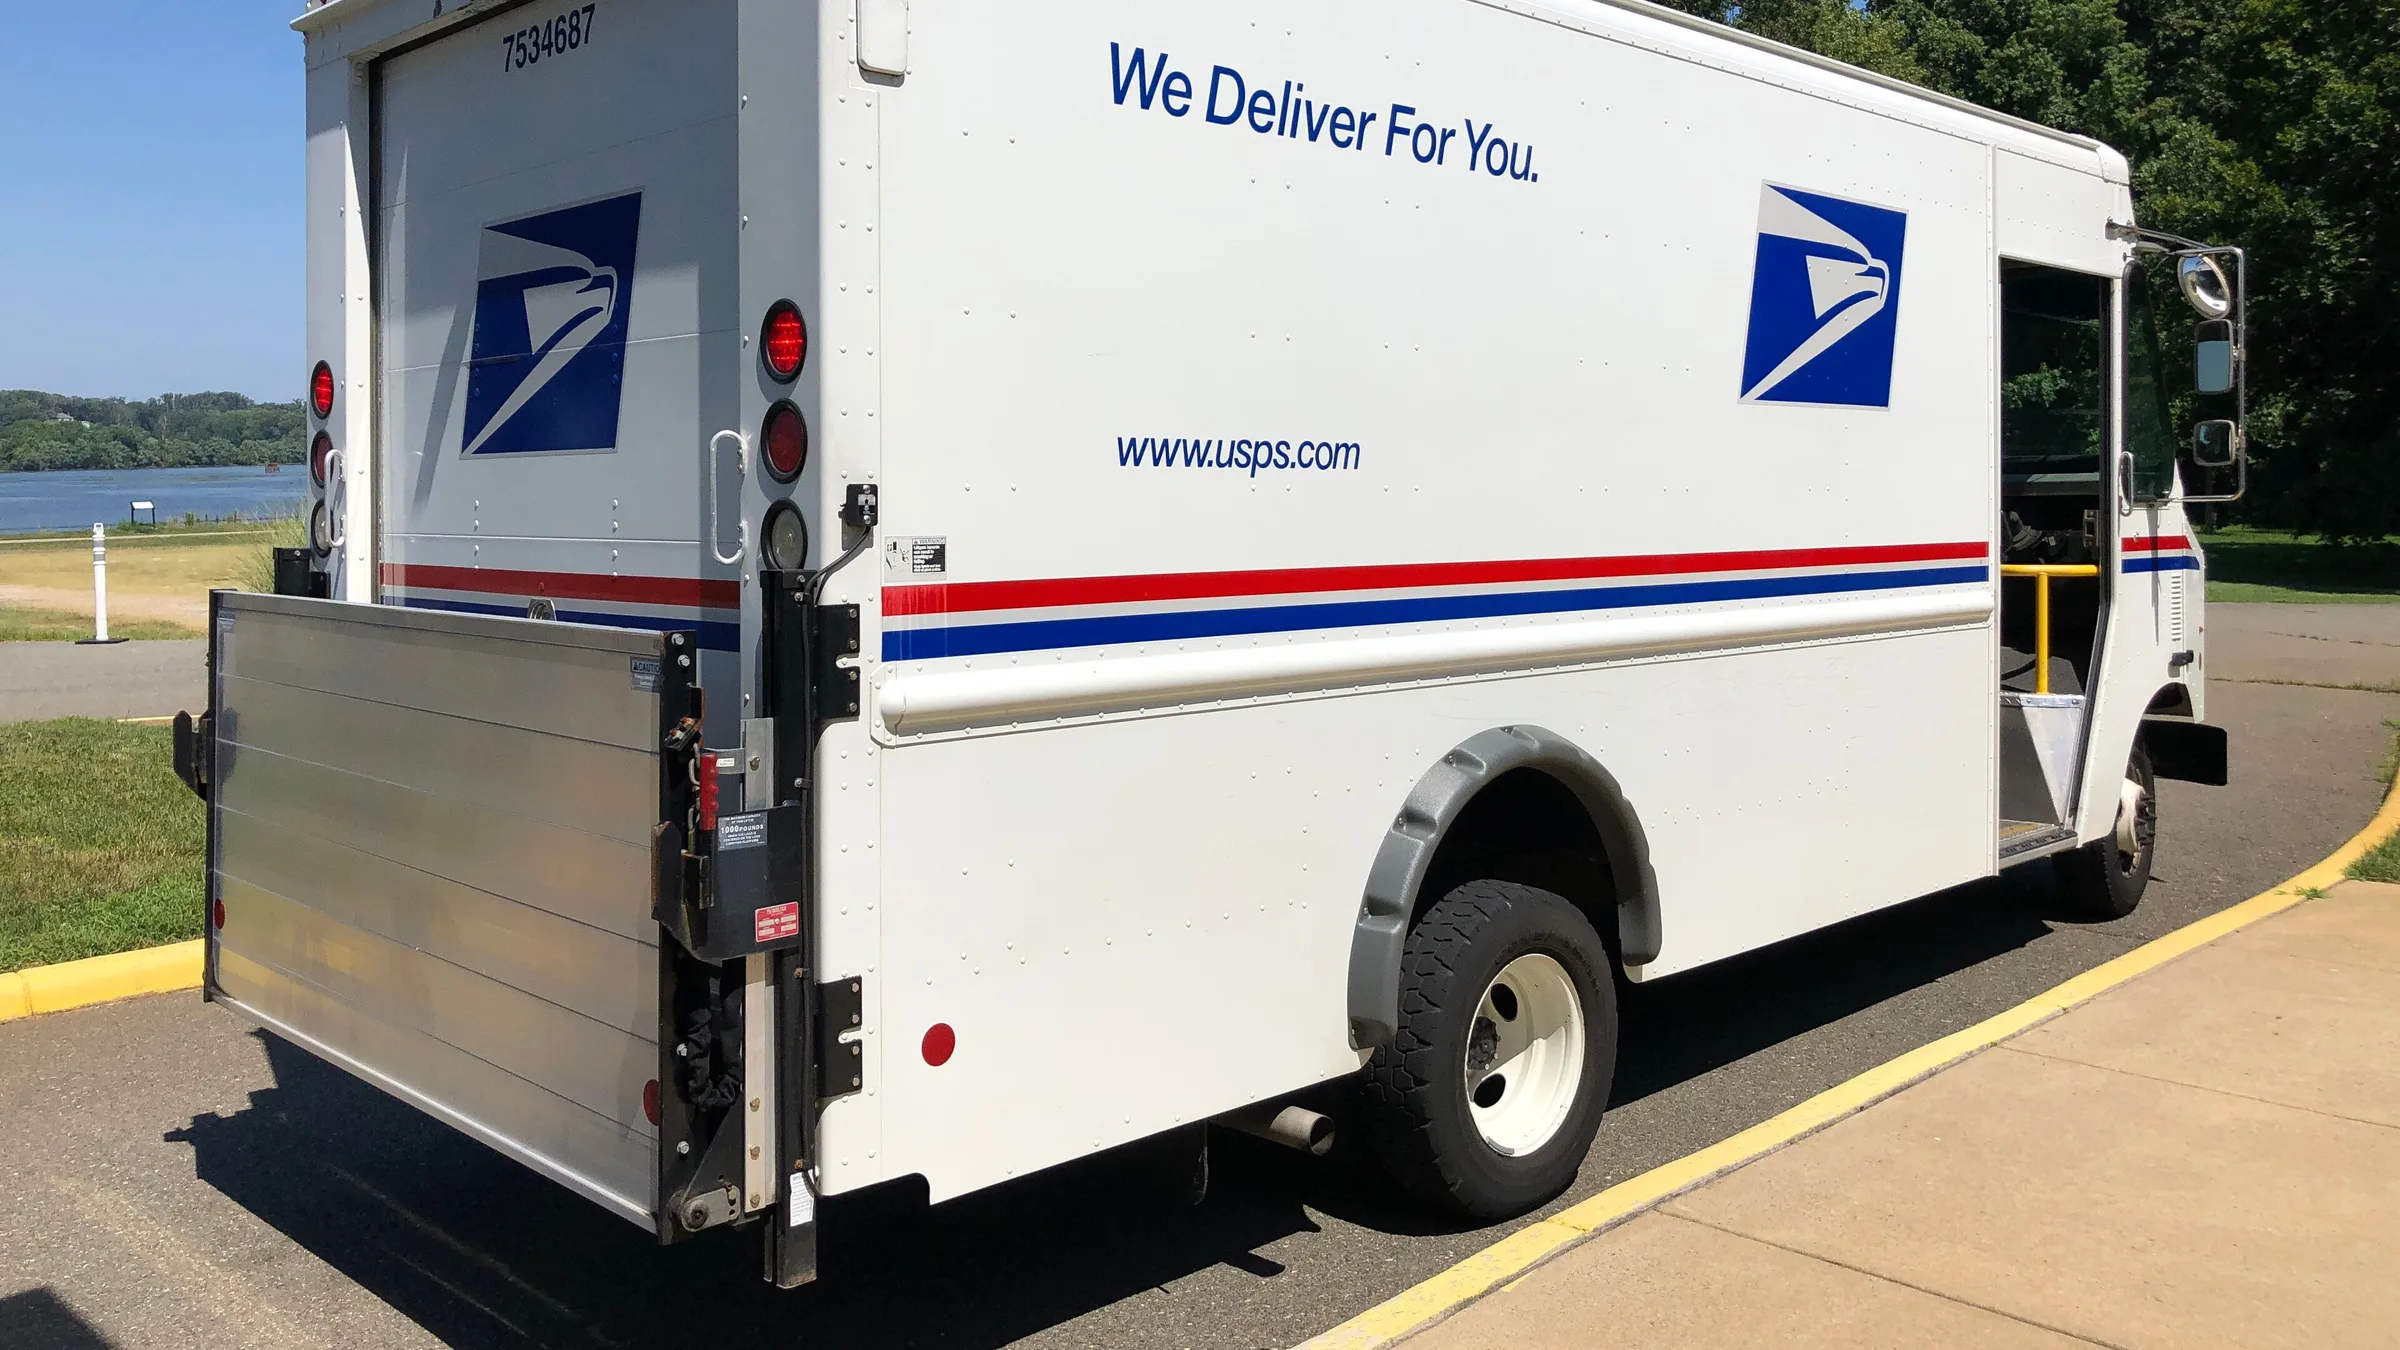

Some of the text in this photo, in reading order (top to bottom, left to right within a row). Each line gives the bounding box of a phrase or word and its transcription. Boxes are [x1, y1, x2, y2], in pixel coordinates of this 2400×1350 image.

[503, 3, 595, 72] 7534687
[1110, 42, 1539, 182] We Deliver For You.
[1117, 436, 1361, 478] www.usps.com
[638, 662, 660, 673] CAUTIO
[721, 825, 738, 833] 1000
